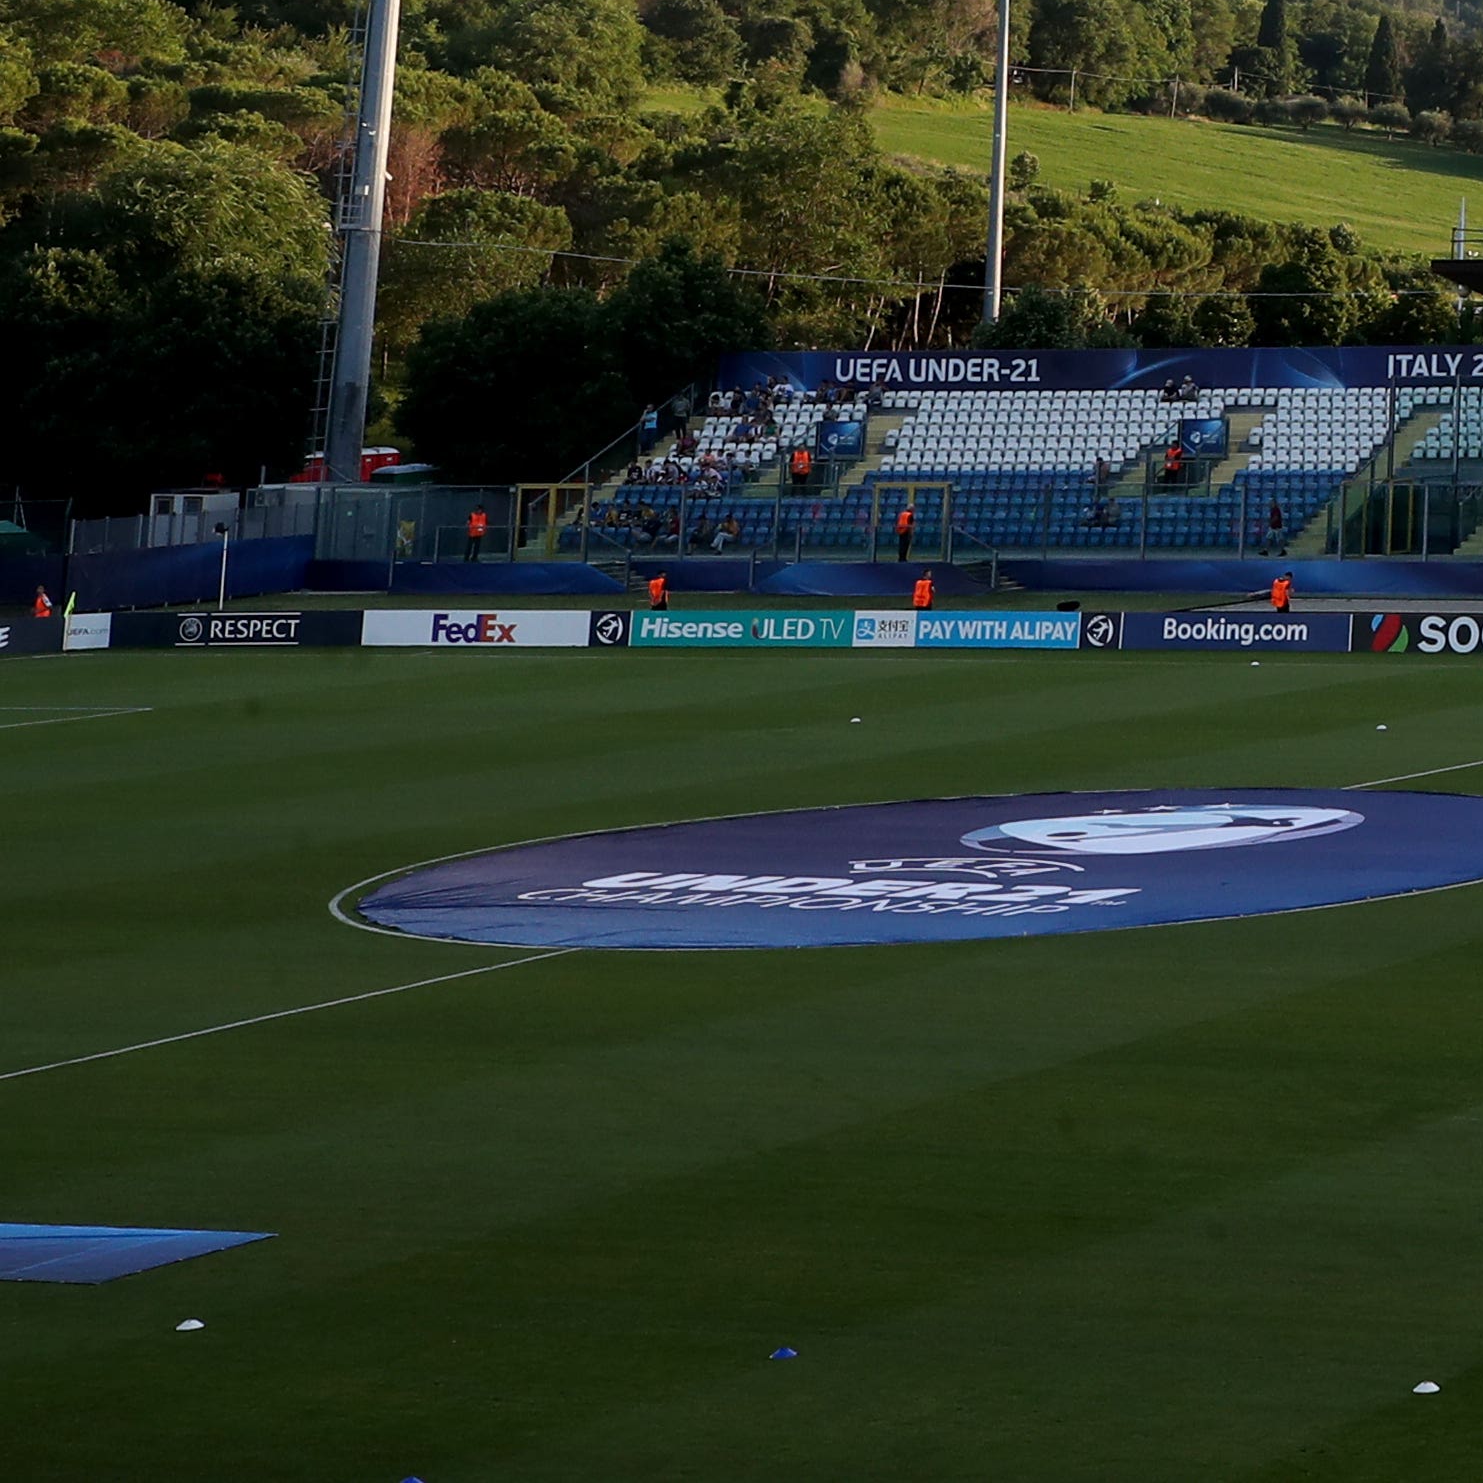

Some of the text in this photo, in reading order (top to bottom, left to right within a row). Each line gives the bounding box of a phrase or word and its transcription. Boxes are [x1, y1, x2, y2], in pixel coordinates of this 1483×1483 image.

[835, 358, 1041, 385] UEFA UNDER-21
[1387, 353, 1464, 379] ITALY
[209, 619, 300, 640] RESPECT
[431, 613, 517, 643] FedEx
[640, 617, 845, 640] Hisense ULED TV
[918, 620, 1077, 641] PAY WITH ALIPAY
[1162, 617, 1308, 646] Booking.com
[582, 872, 1142, 905] UNDER21
[517, 888, 1070, 917] CHAMPIONSHIP
